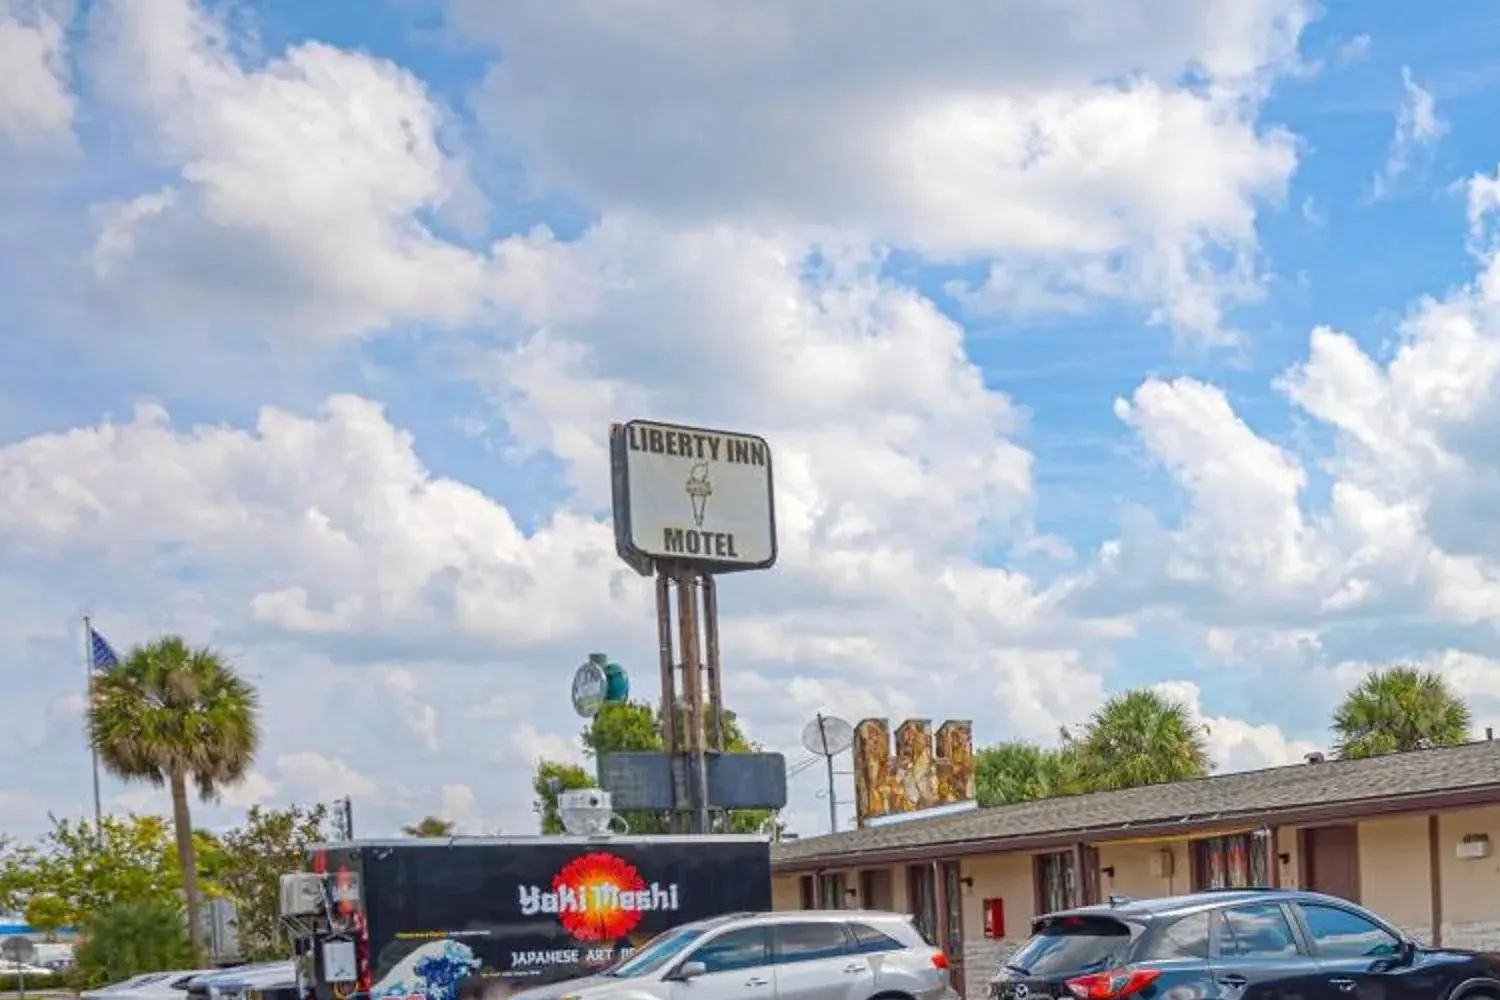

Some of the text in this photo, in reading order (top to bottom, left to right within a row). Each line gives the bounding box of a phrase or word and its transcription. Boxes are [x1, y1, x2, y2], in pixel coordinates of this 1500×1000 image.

[630, 425, 765, 466] LIBERTY INN
[664, 527, 738, 558] MOTEL
[518, 881, 679, 916] Yaki Meshi
[511, 948, 580, 967] JAPANESE
[585, 948, 614, 961] ART
